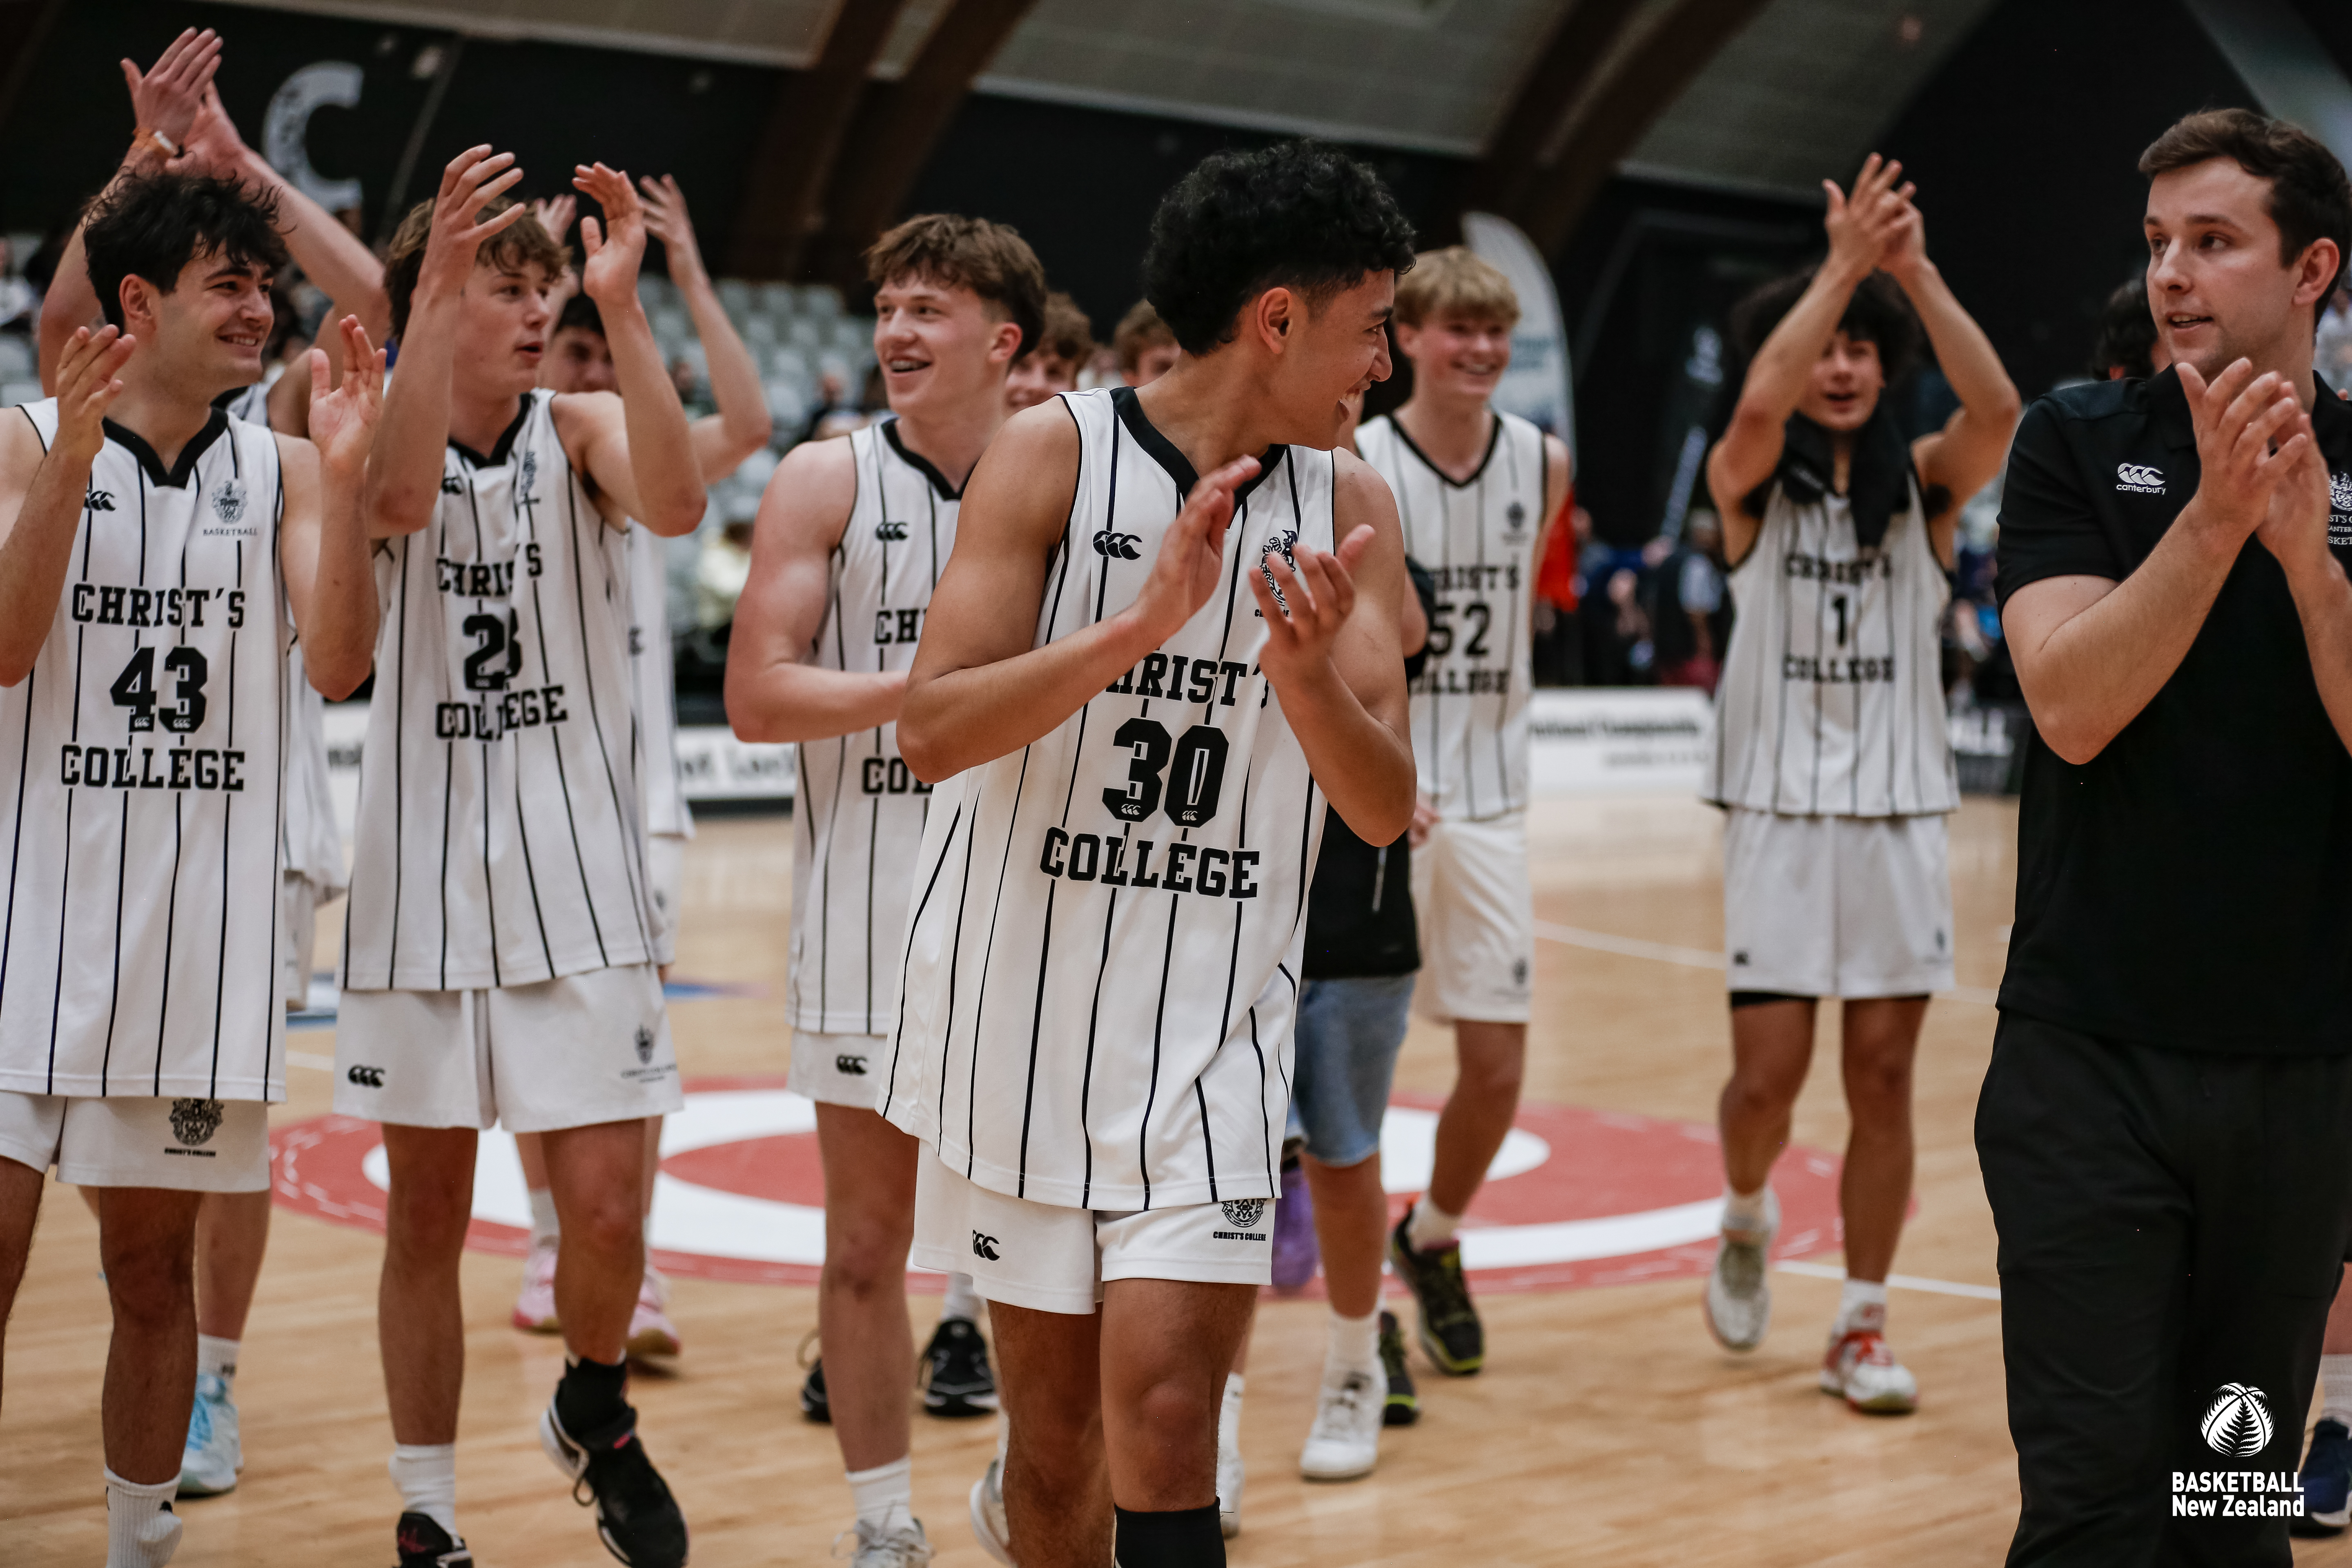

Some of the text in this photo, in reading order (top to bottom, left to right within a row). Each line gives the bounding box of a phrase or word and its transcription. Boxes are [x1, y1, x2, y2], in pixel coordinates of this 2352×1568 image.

[2116, 484, 2166, 495] canterbury
[71, 584, 245, 628] CHRIST'S
[1428, 603, 1491, 658] 52
[1831, 596, 1846, 646] 1
[109, 646, 208, 733] 43
[61, 744, 245, 791] COLLEGE
[1102, 717, 1229, 829] 30
[1039, 826, 1260, 899] COLLEGE
[1213, 1231, 1266, 1241] CHRIST'S COLLEGE
